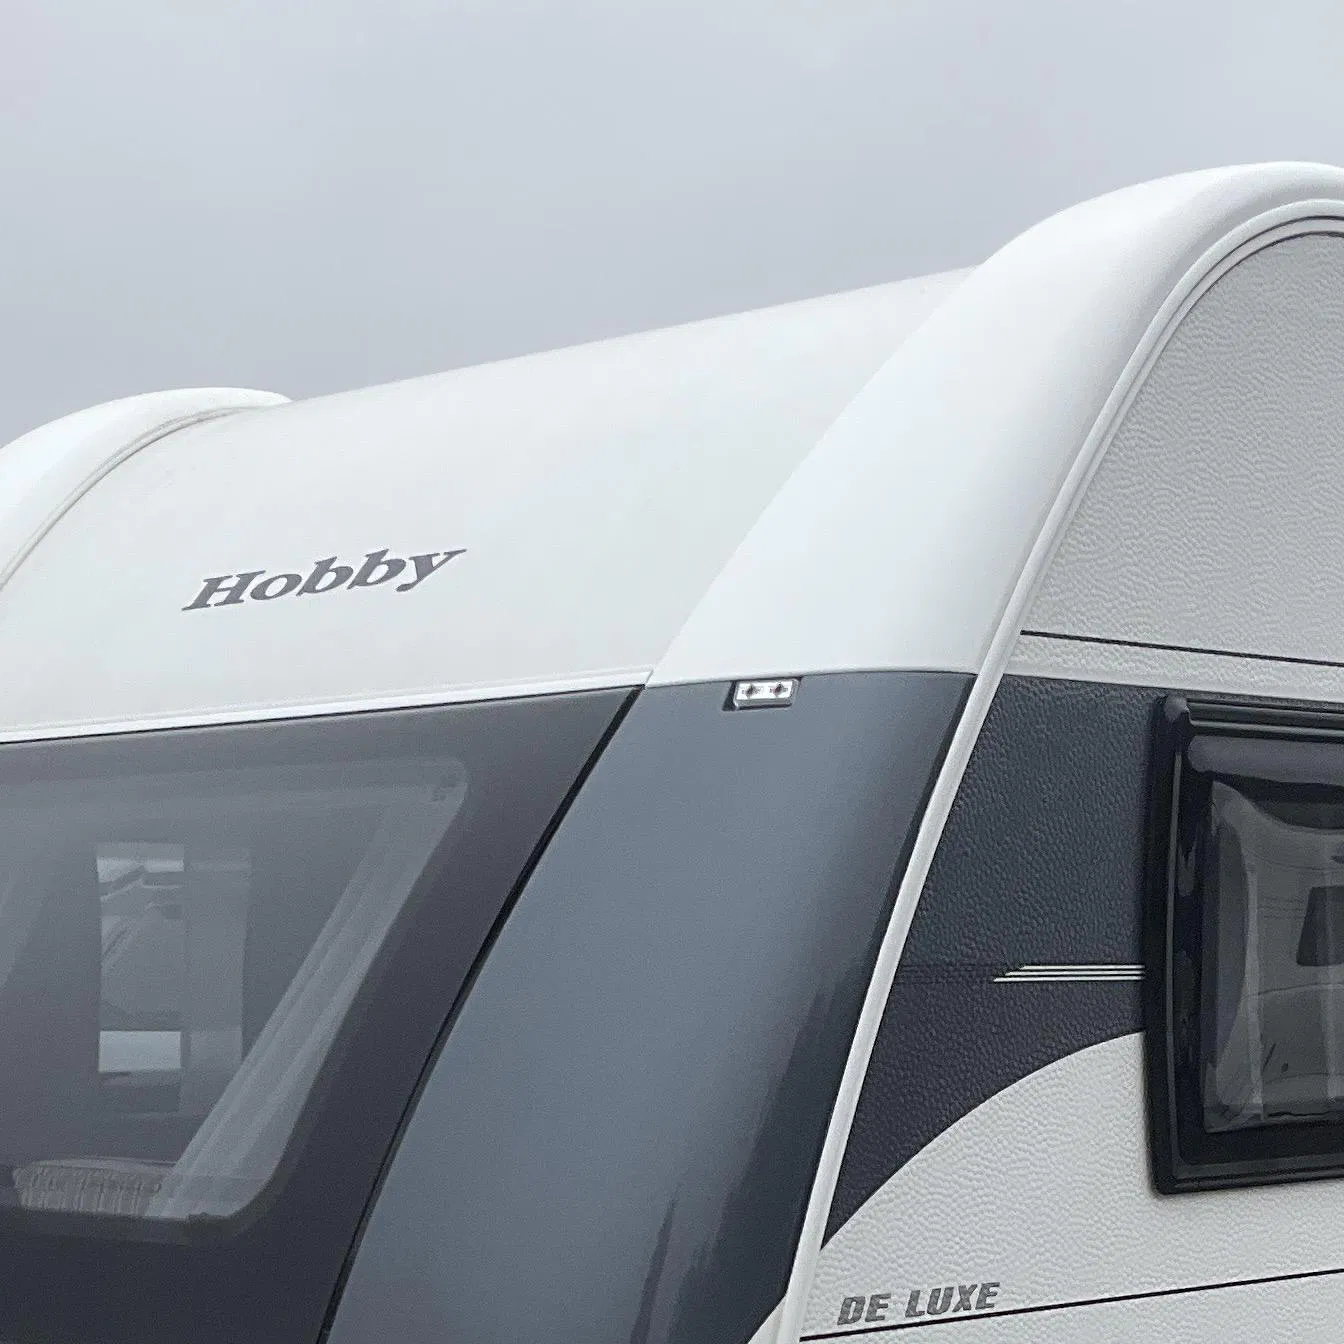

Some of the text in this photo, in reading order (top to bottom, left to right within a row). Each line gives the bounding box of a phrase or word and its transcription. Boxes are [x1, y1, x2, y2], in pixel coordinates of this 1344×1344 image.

[181, 548, 468, 611] Hobby
[837, 1281, 1001, 1325] DE LUXE
